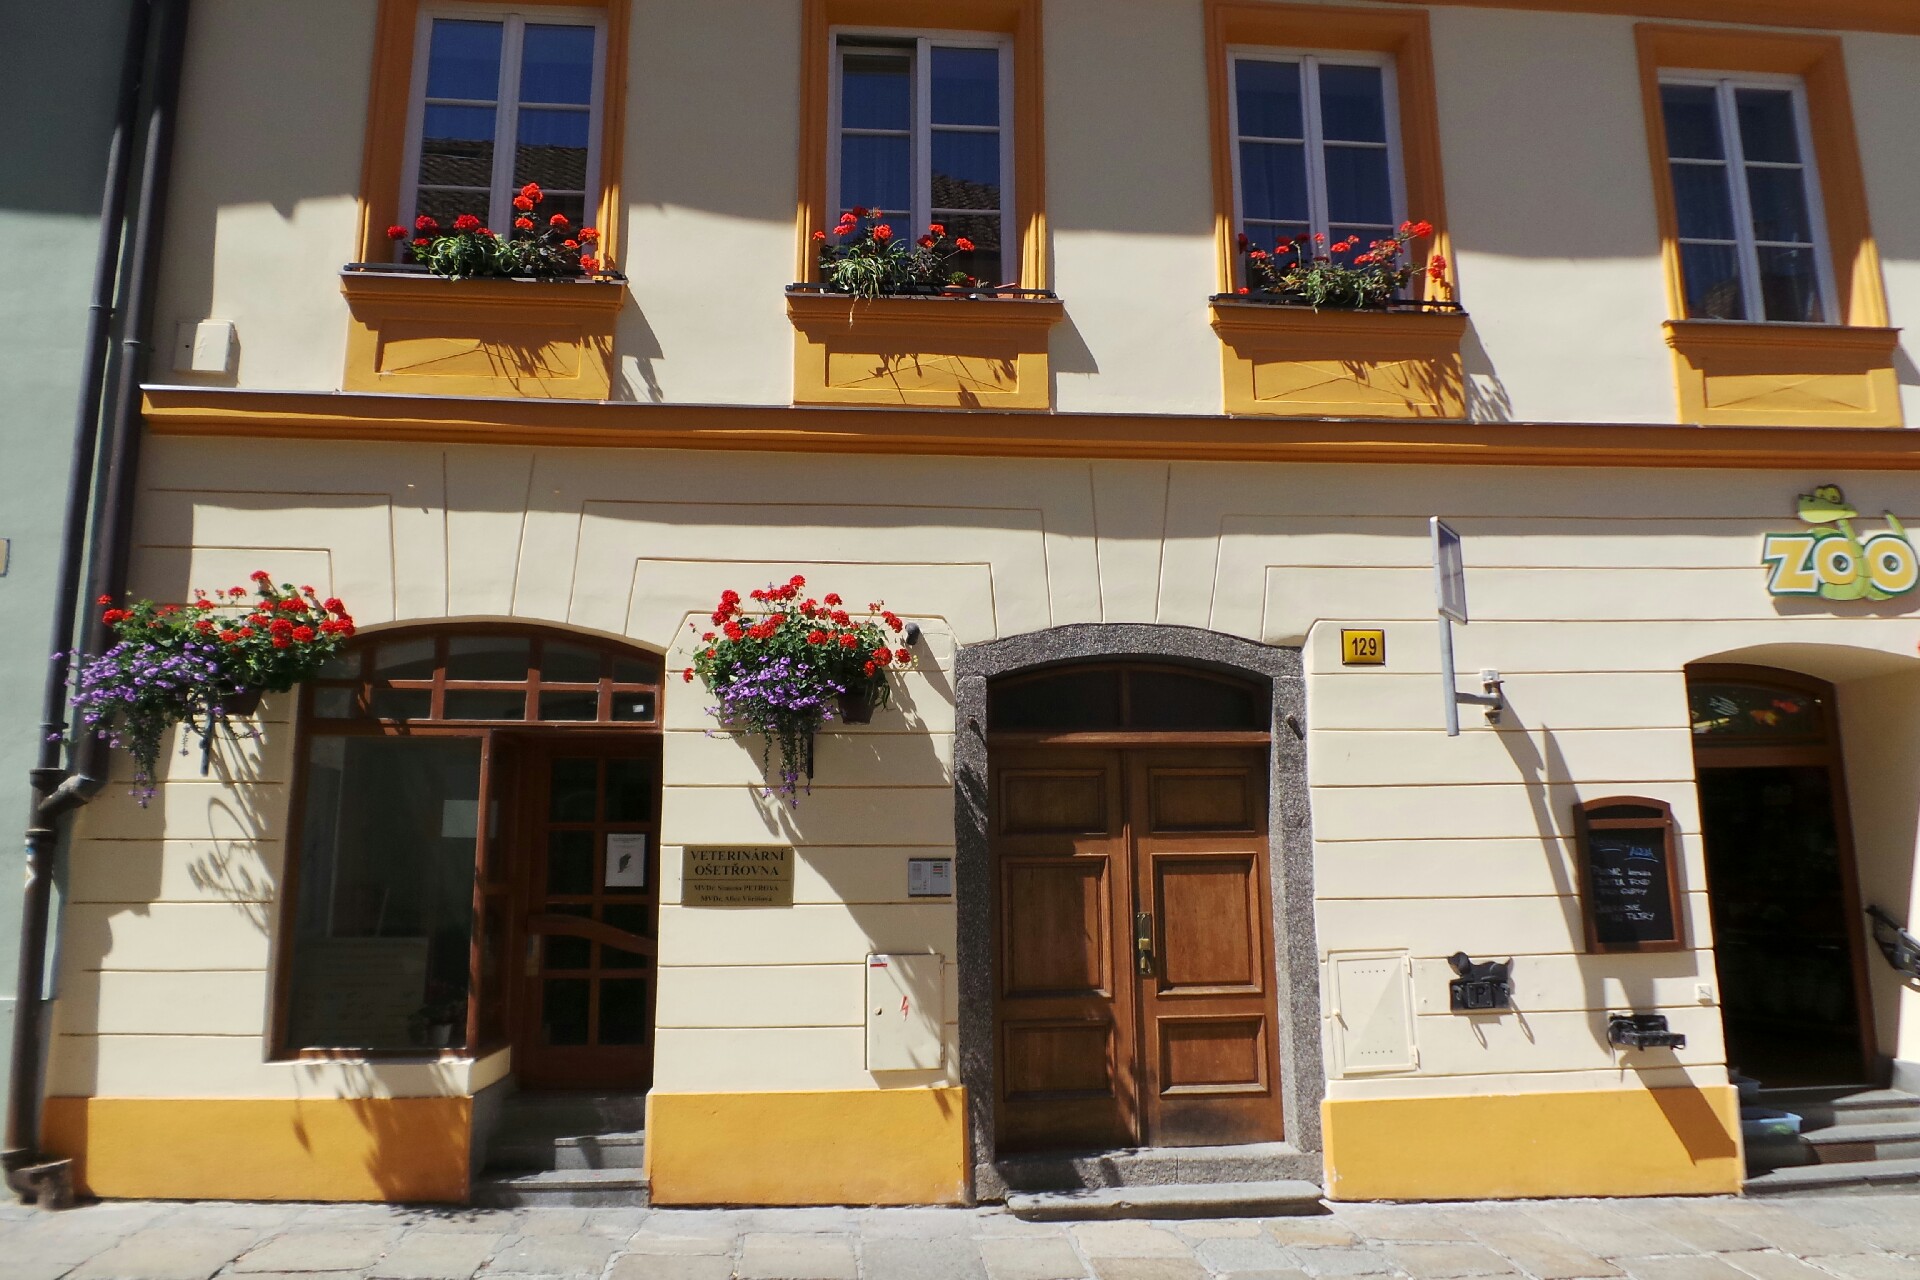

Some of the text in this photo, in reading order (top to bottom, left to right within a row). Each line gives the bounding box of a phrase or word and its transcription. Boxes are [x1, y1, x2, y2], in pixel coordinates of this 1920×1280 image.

[1761, 533, 1919, 597] ZOO
[1352, 637, 1377, 656] 129
[691, 848, 784, 860] VETERINÁRNÍ
[695, 863, 779, 875] OŠETŘOVNA
